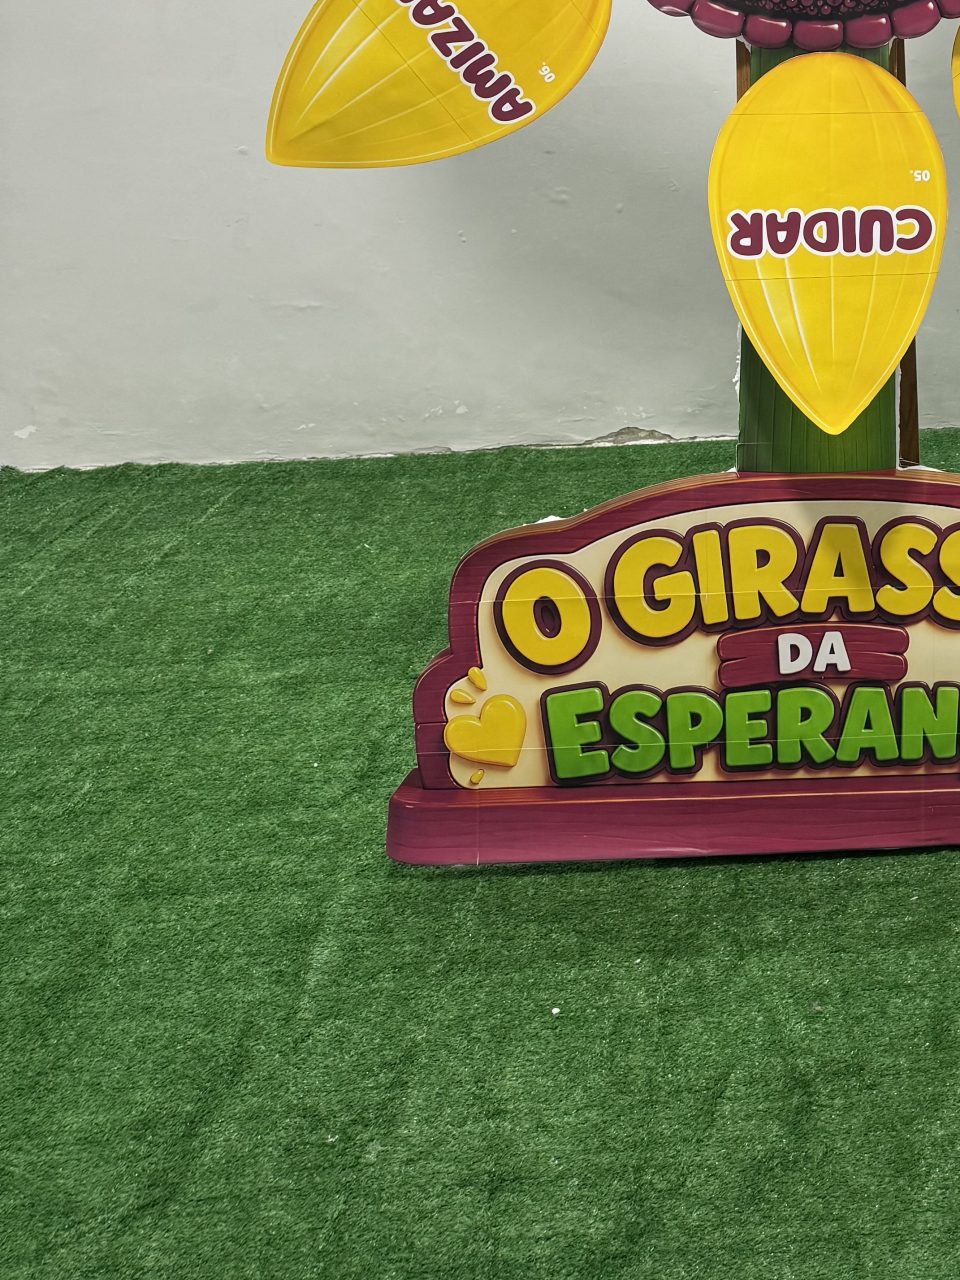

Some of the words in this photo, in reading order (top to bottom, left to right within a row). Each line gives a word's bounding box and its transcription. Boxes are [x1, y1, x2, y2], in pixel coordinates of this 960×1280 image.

[538, 62, 555, 83] 06.
[909, 169, 931, 182] 05.
[728, 207, 934, 256] CUIDAR
[499, 565, 598, 670] O
[778, 631, 851, 675] DA
